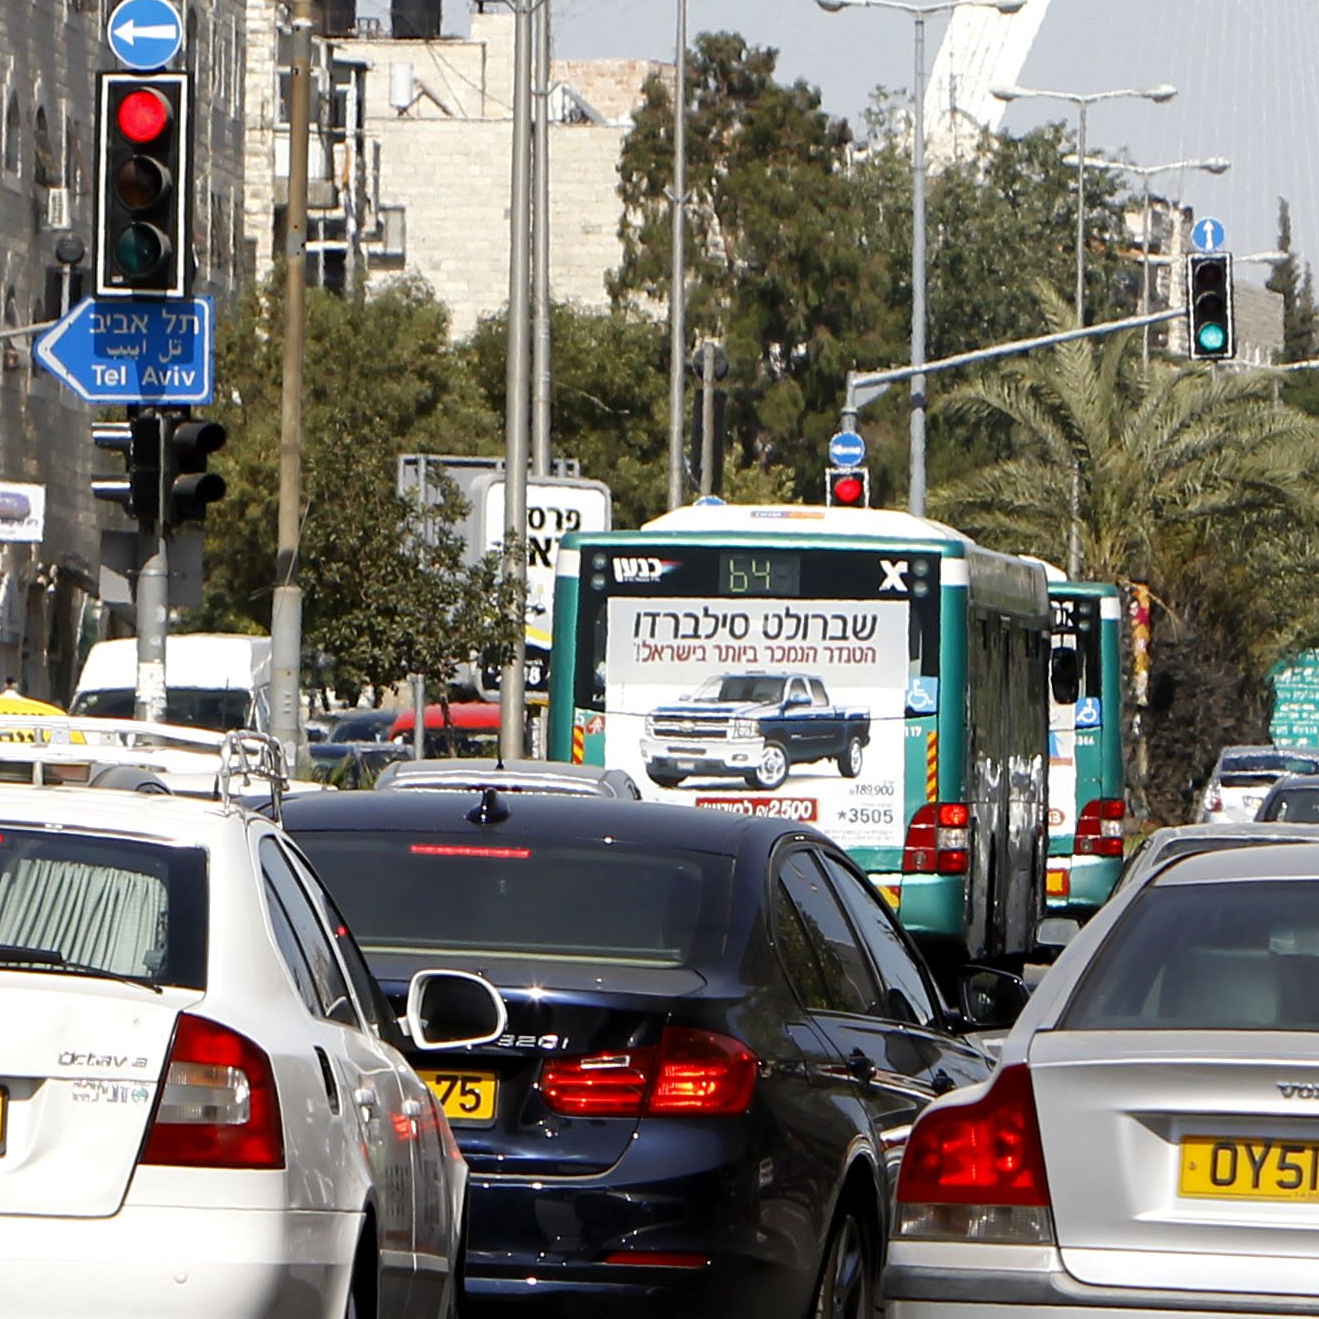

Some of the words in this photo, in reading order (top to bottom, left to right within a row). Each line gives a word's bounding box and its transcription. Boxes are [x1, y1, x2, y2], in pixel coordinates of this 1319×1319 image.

[89, 313, 149, 334] אביב
[161, 308, 200, 335] תל
[158, 338, 183, 363] تل
[91, 364, 127, 387] Tel
[141, 365, 196, 387] Aviv
[633, 606, 749, 641] סילברדו
[761, 606, 879, 642] שברולט
[634, 640, 707, 663] בישראל!
[713, 644, 758, 663] ביותר
[765, 644, 818, 664] הנמכר
[823, 644, 877, 664] הטנדר
[57, 1049, 149, 1069] Octava
[434, 1074, 483, 1113] 75
[1209, 1138, 1319, 1191] OY51
